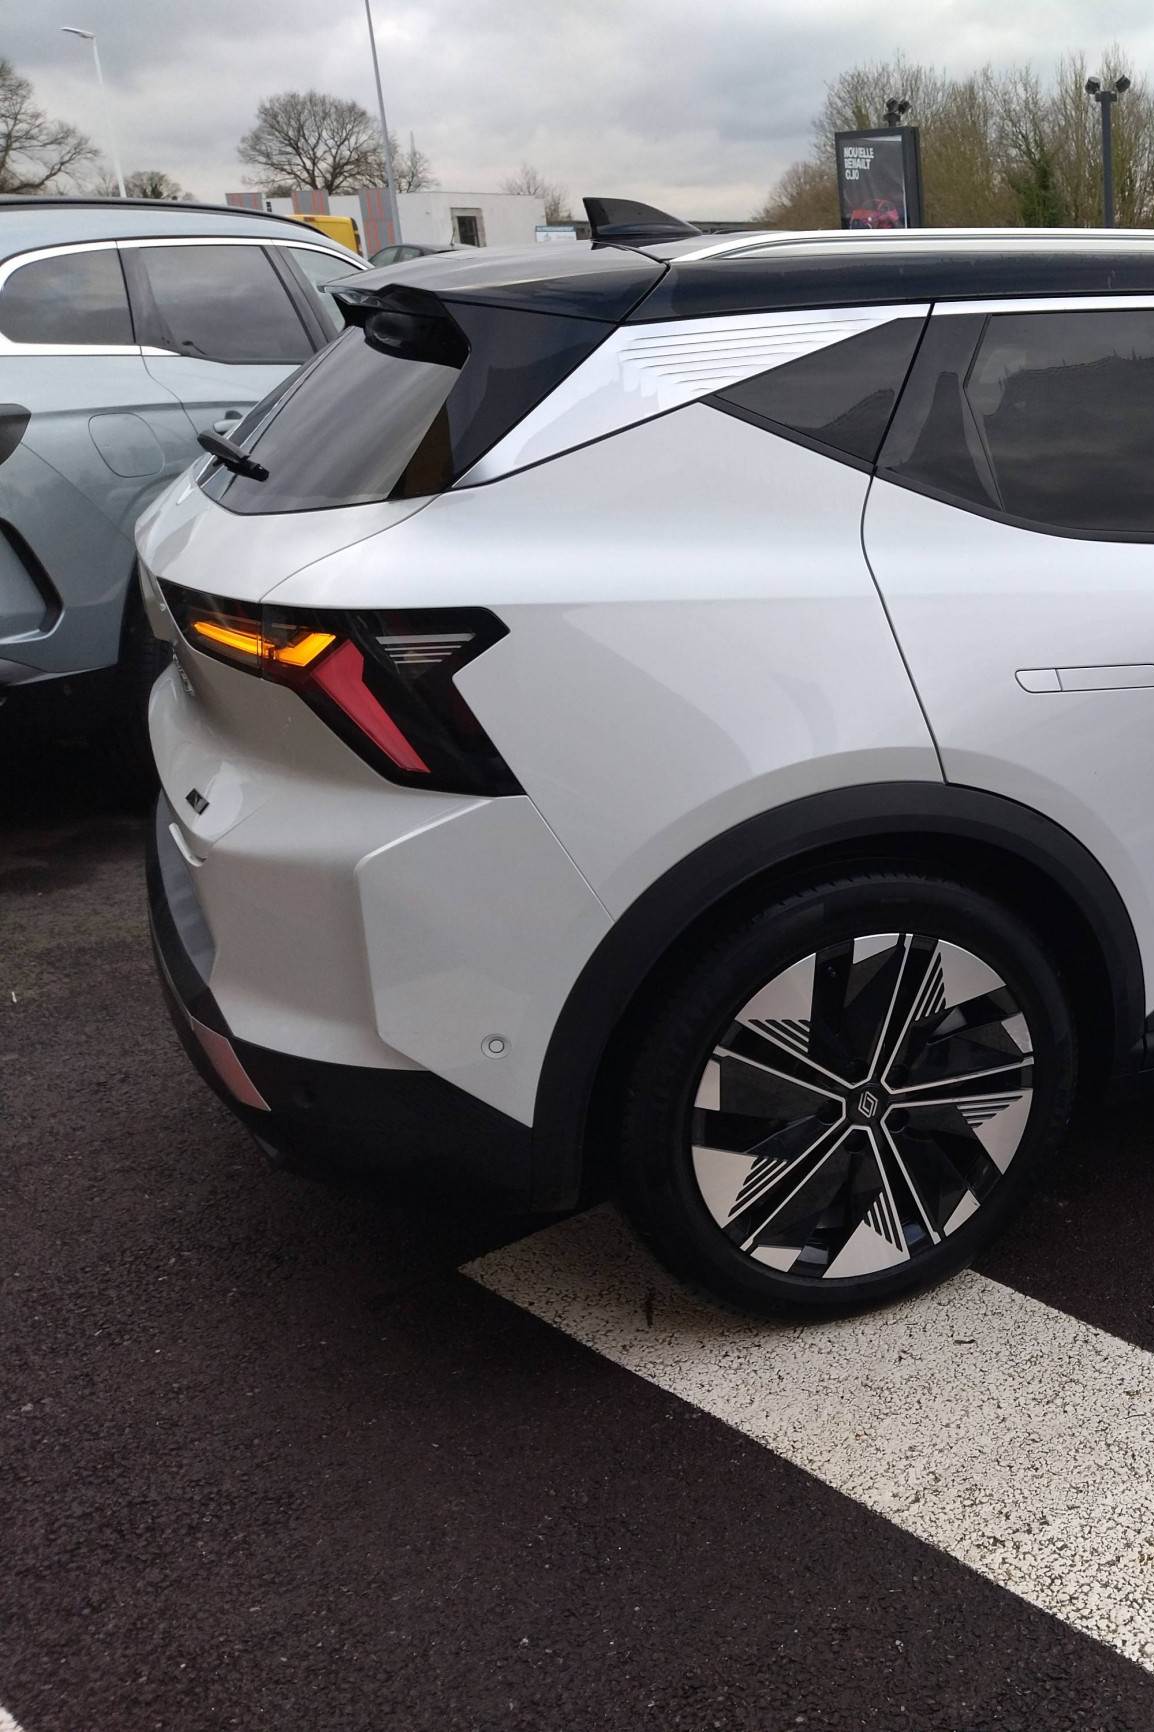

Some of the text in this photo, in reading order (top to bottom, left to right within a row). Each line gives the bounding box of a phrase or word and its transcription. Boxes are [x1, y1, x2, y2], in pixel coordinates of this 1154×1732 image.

[843, 147, 874, 159] NOUVELLE
[844, 158, 871, 170] RENAULT
[845, 169, 860, 180] CLIO
